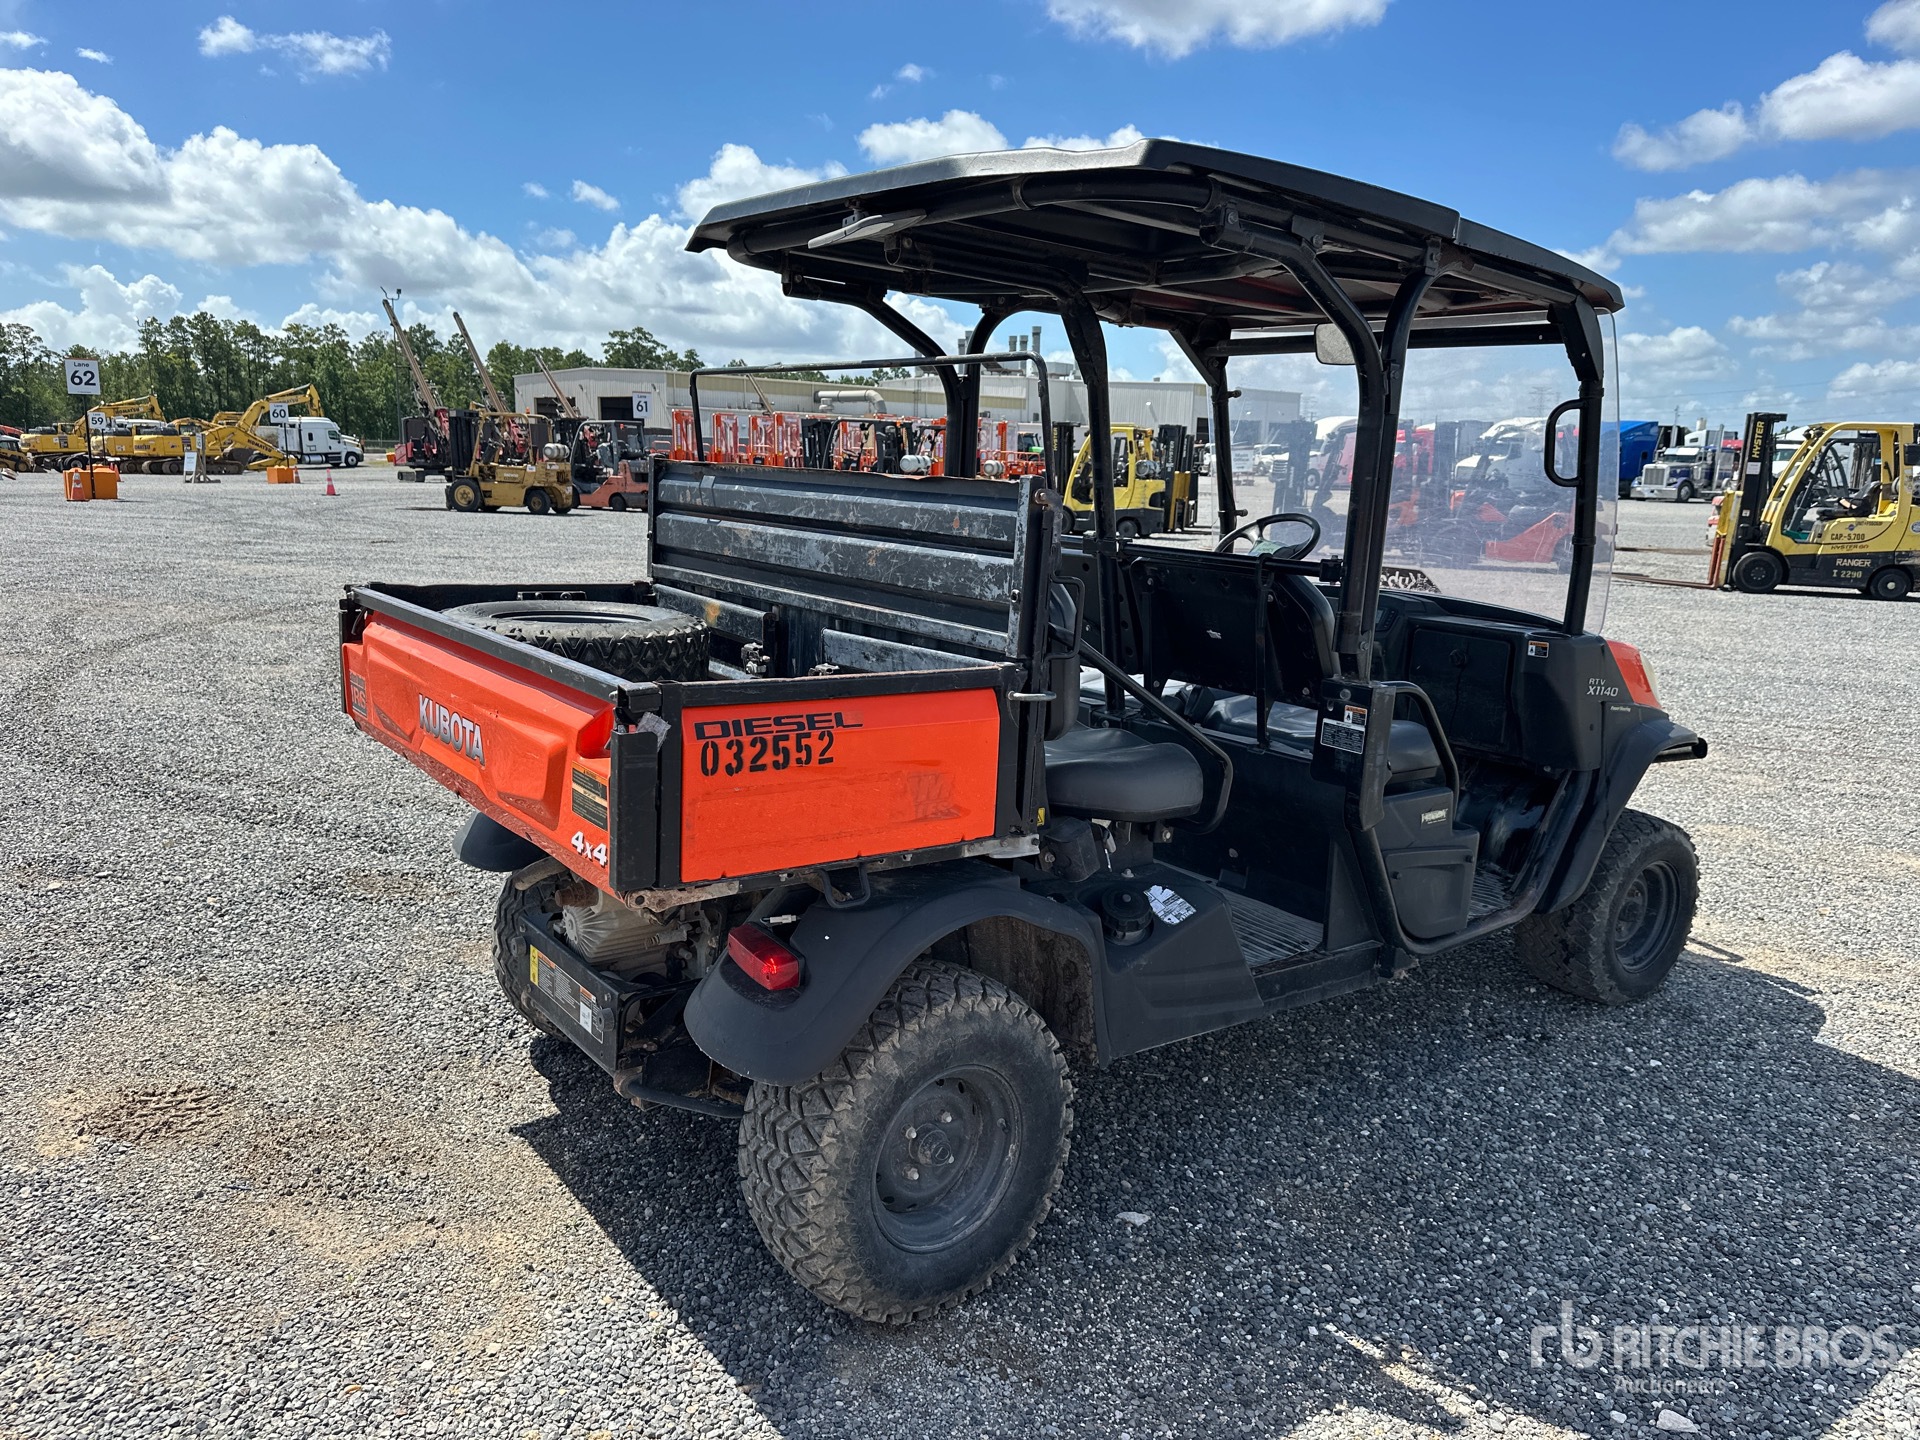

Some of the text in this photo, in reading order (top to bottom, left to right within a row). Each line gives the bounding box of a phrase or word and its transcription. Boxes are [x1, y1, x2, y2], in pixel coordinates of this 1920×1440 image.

[70, 370, 97, 386] 62
[272, 408, 287, 419] 60
[636, 400, 648, 413] 61
[91, 416, 104, 425] 59
[247, 438, 273, 453] KOMATSU
[1752, 420, 1765, 459] HYSTER
[1836, 559, 1872, 567] RANGER
[1840, 570, 1862, 578] 2290
[1586, 686, 1619, 697] X1140
[418, 692, 486, 767] KUBOTA
[694, 712, 863, 740] DIESEL
[701, 730, 834, 777] 032552
[571, 831, 608, 868] 4x4
